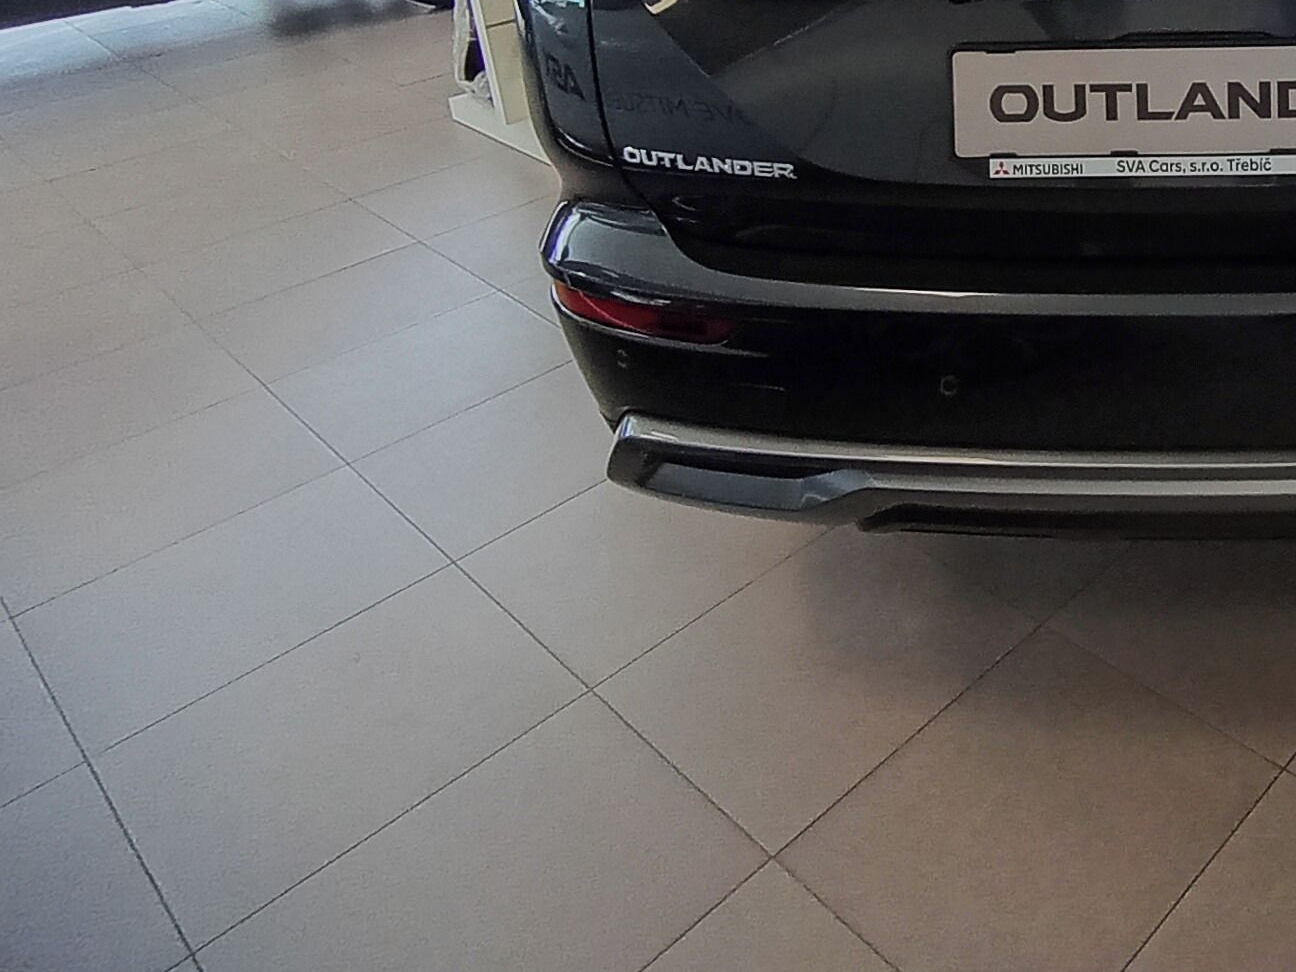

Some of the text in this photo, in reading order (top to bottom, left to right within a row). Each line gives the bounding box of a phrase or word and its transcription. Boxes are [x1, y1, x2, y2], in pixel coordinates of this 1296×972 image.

[622, 146, 797, 180] OUTLANDER
[1012, 163, 1084, 176] MITSUBISHI
[1116, 159, 1146, 174] SVA
[1148, 159, 1187, 175] Cars,
[1189, 160, 1224, 173] s.r.o.
[1226, 158, 1272, 173] Třebíč
